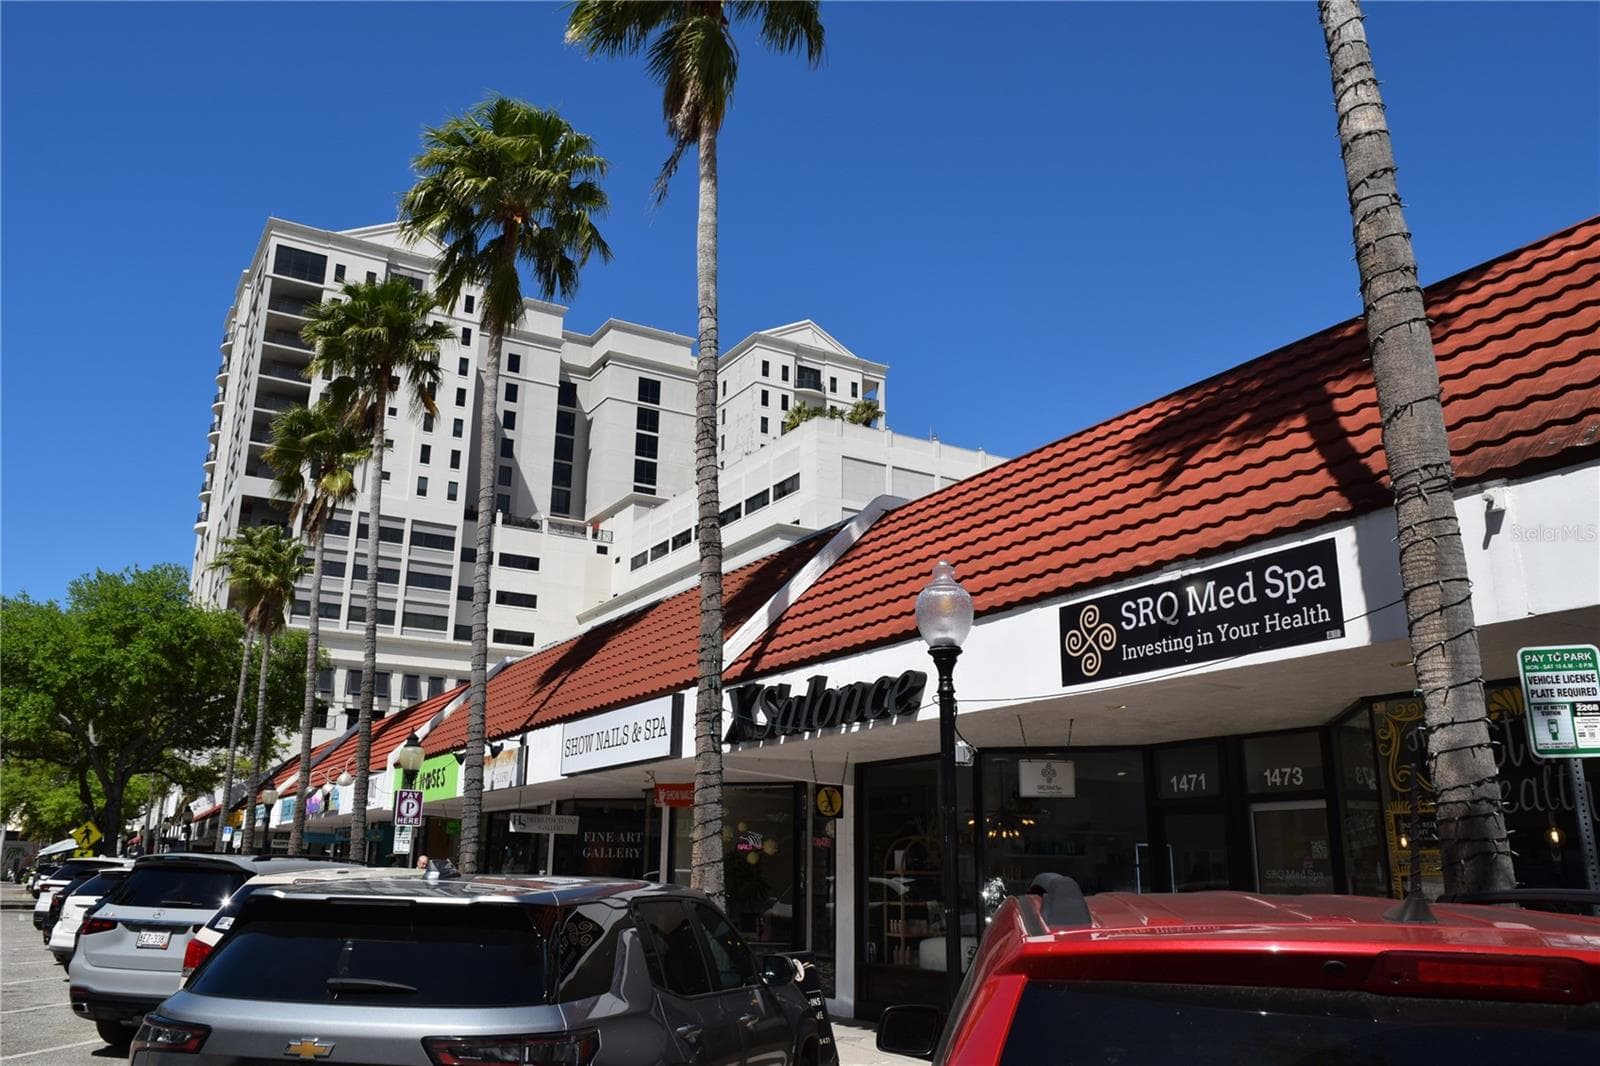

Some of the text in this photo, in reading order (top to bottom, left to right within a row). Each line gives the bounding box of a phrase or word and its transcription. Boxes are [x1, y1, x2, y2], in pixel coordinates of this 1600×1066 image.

[1121, 565, 1326, 631] SRQ Med Spa
[1121, 604, 1331, 660] Investing in Your Health
[1524, 652, 1592, 663] PAY TO PARK
[1527, 673, 1597, 685] VEHICLE LICENSE
[1530, 687, 1598, 698] PLATE REQUIRED
[564, 716, 668, 757] SHOW NAILS & SPA
[1170, 773, 1206, 792] 1471
[1264, 767, 1304, 786] 1473
[405, 801, 415, 814] P
[396, 817, 419, 825] HERE
[584, 831, 643, 842] FINE ART
[582, 847, 641, 858] GALLERY
